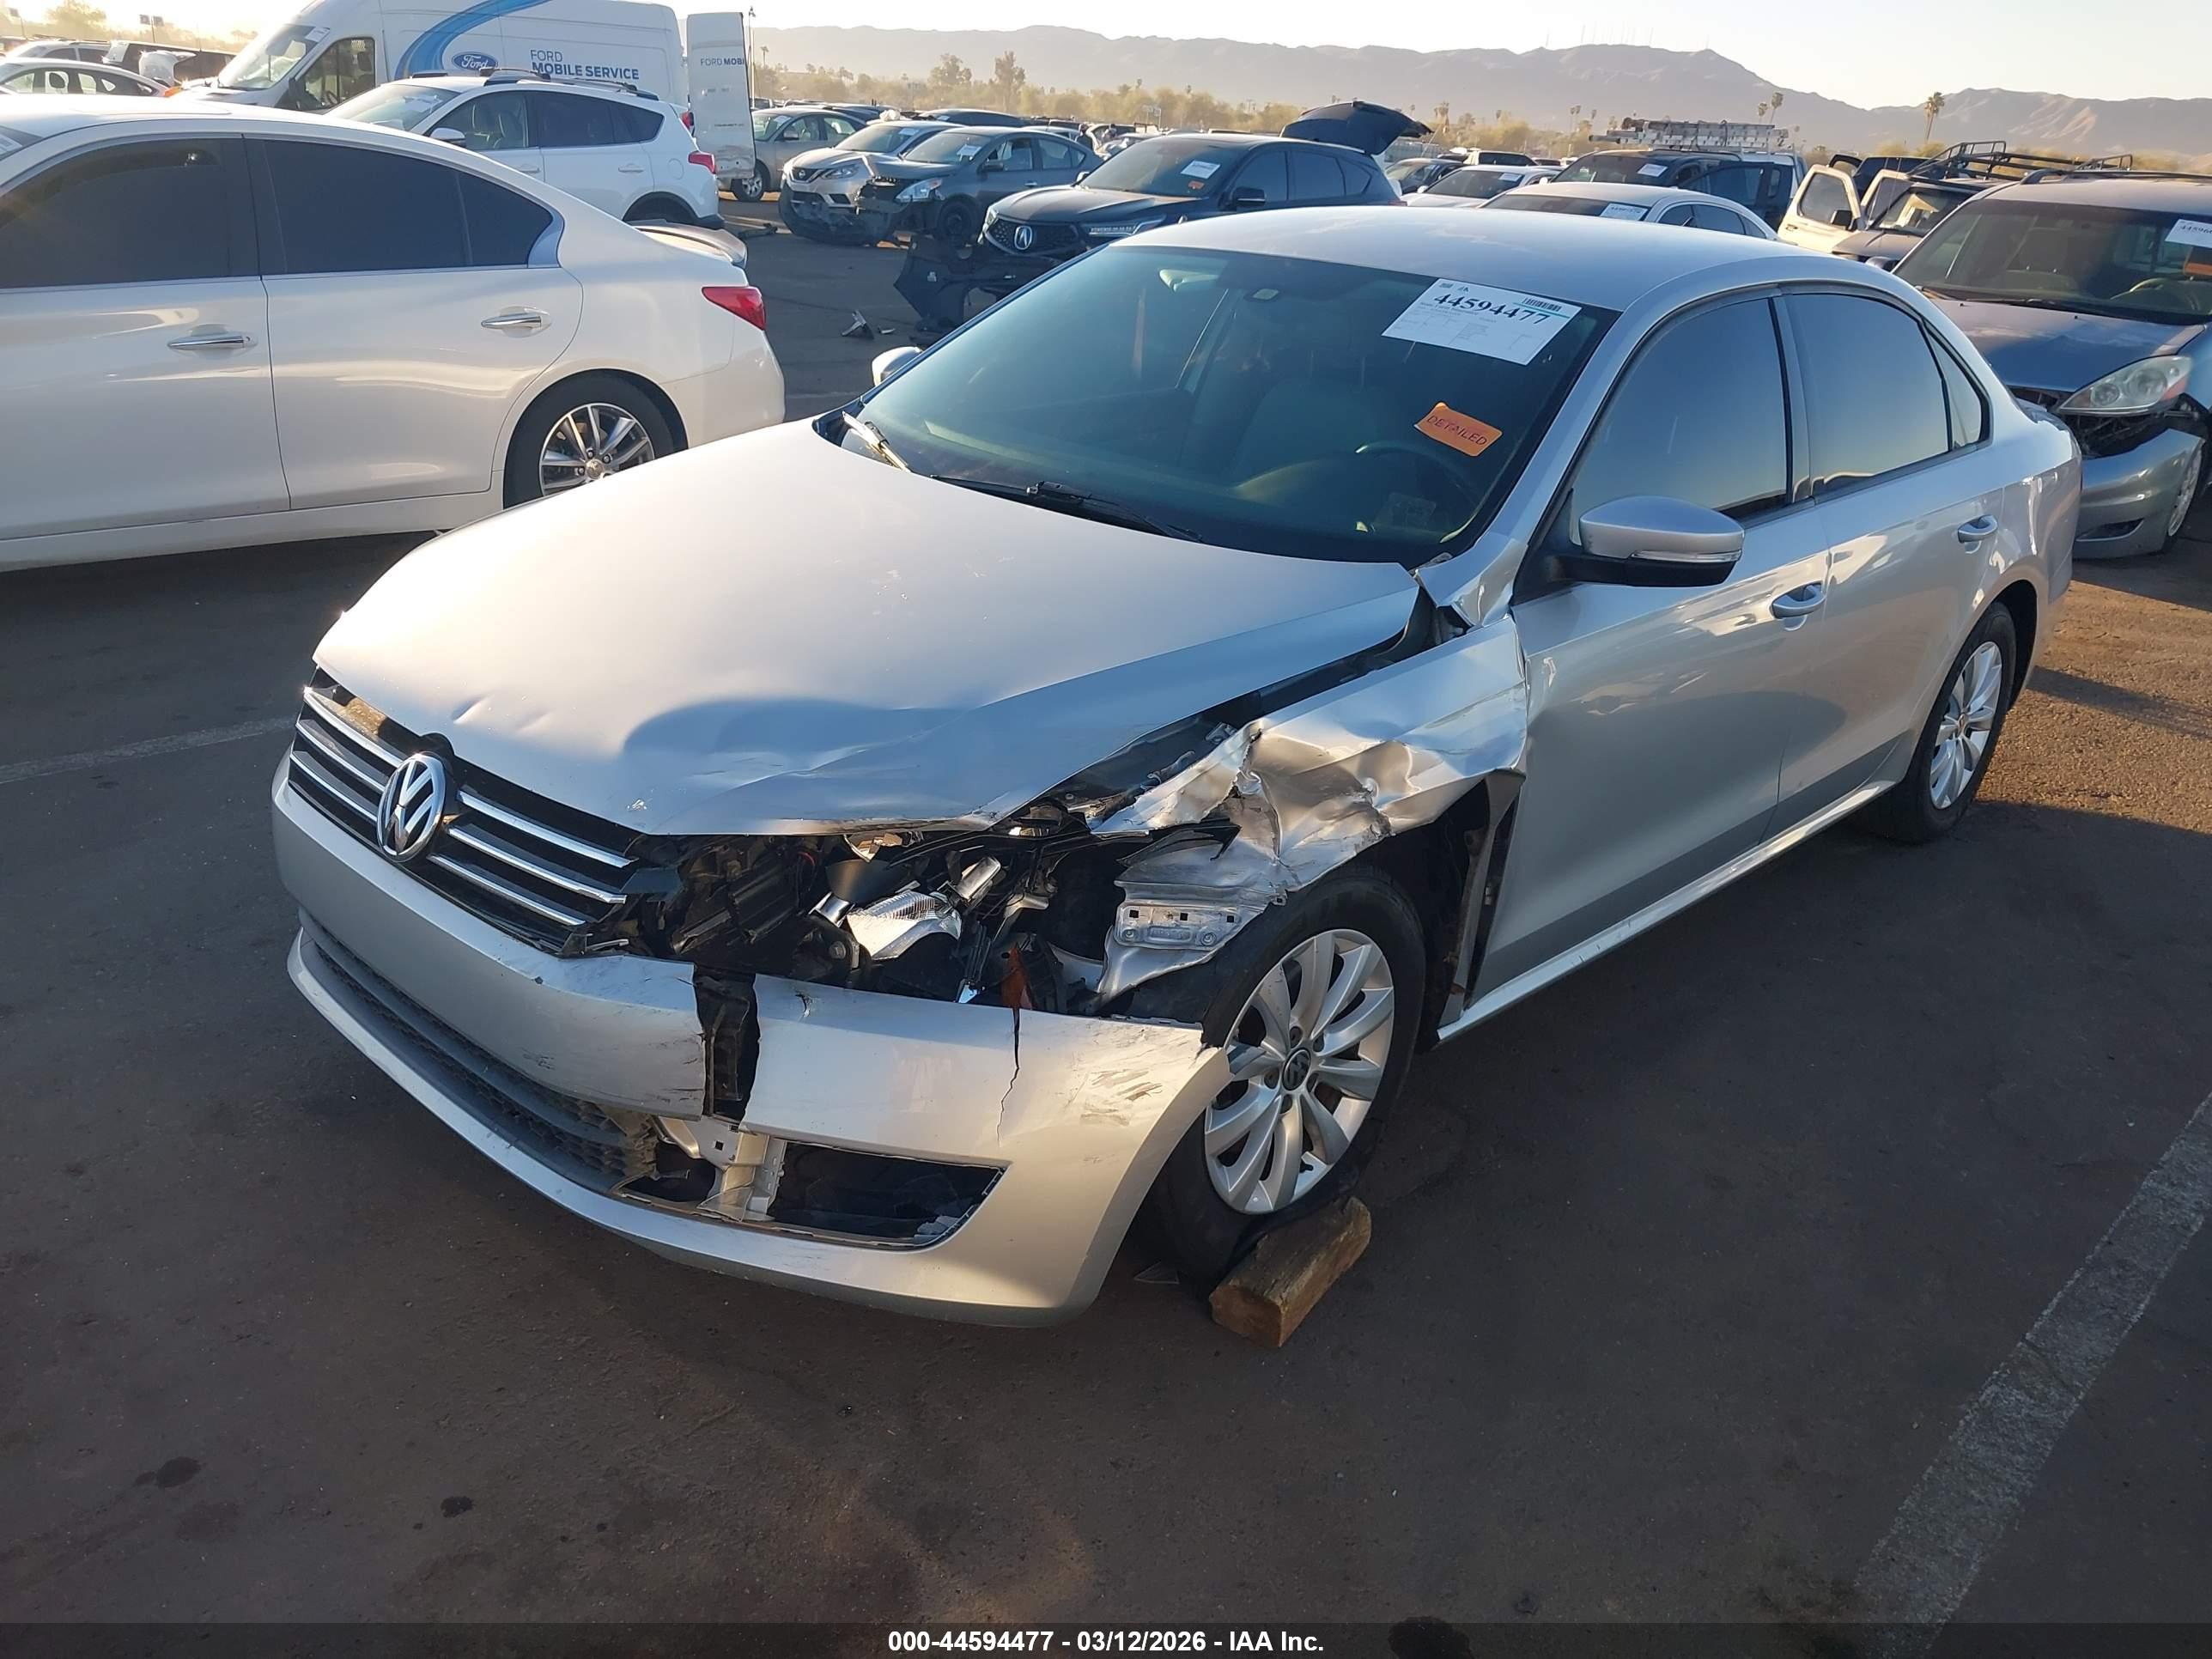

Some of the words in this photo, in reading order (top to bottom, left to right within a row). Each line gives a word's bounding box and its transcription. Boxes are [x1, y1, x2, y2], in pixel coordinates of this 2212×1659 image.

[531, 50, 562, 62] FORD
[532, 62, 583, 76] MOBILE
[585, 66, 639, 80] SERVICE
[1434, 294, 1551, 325] 44594477
[1426, 415, 1487, 446] DETAILED
